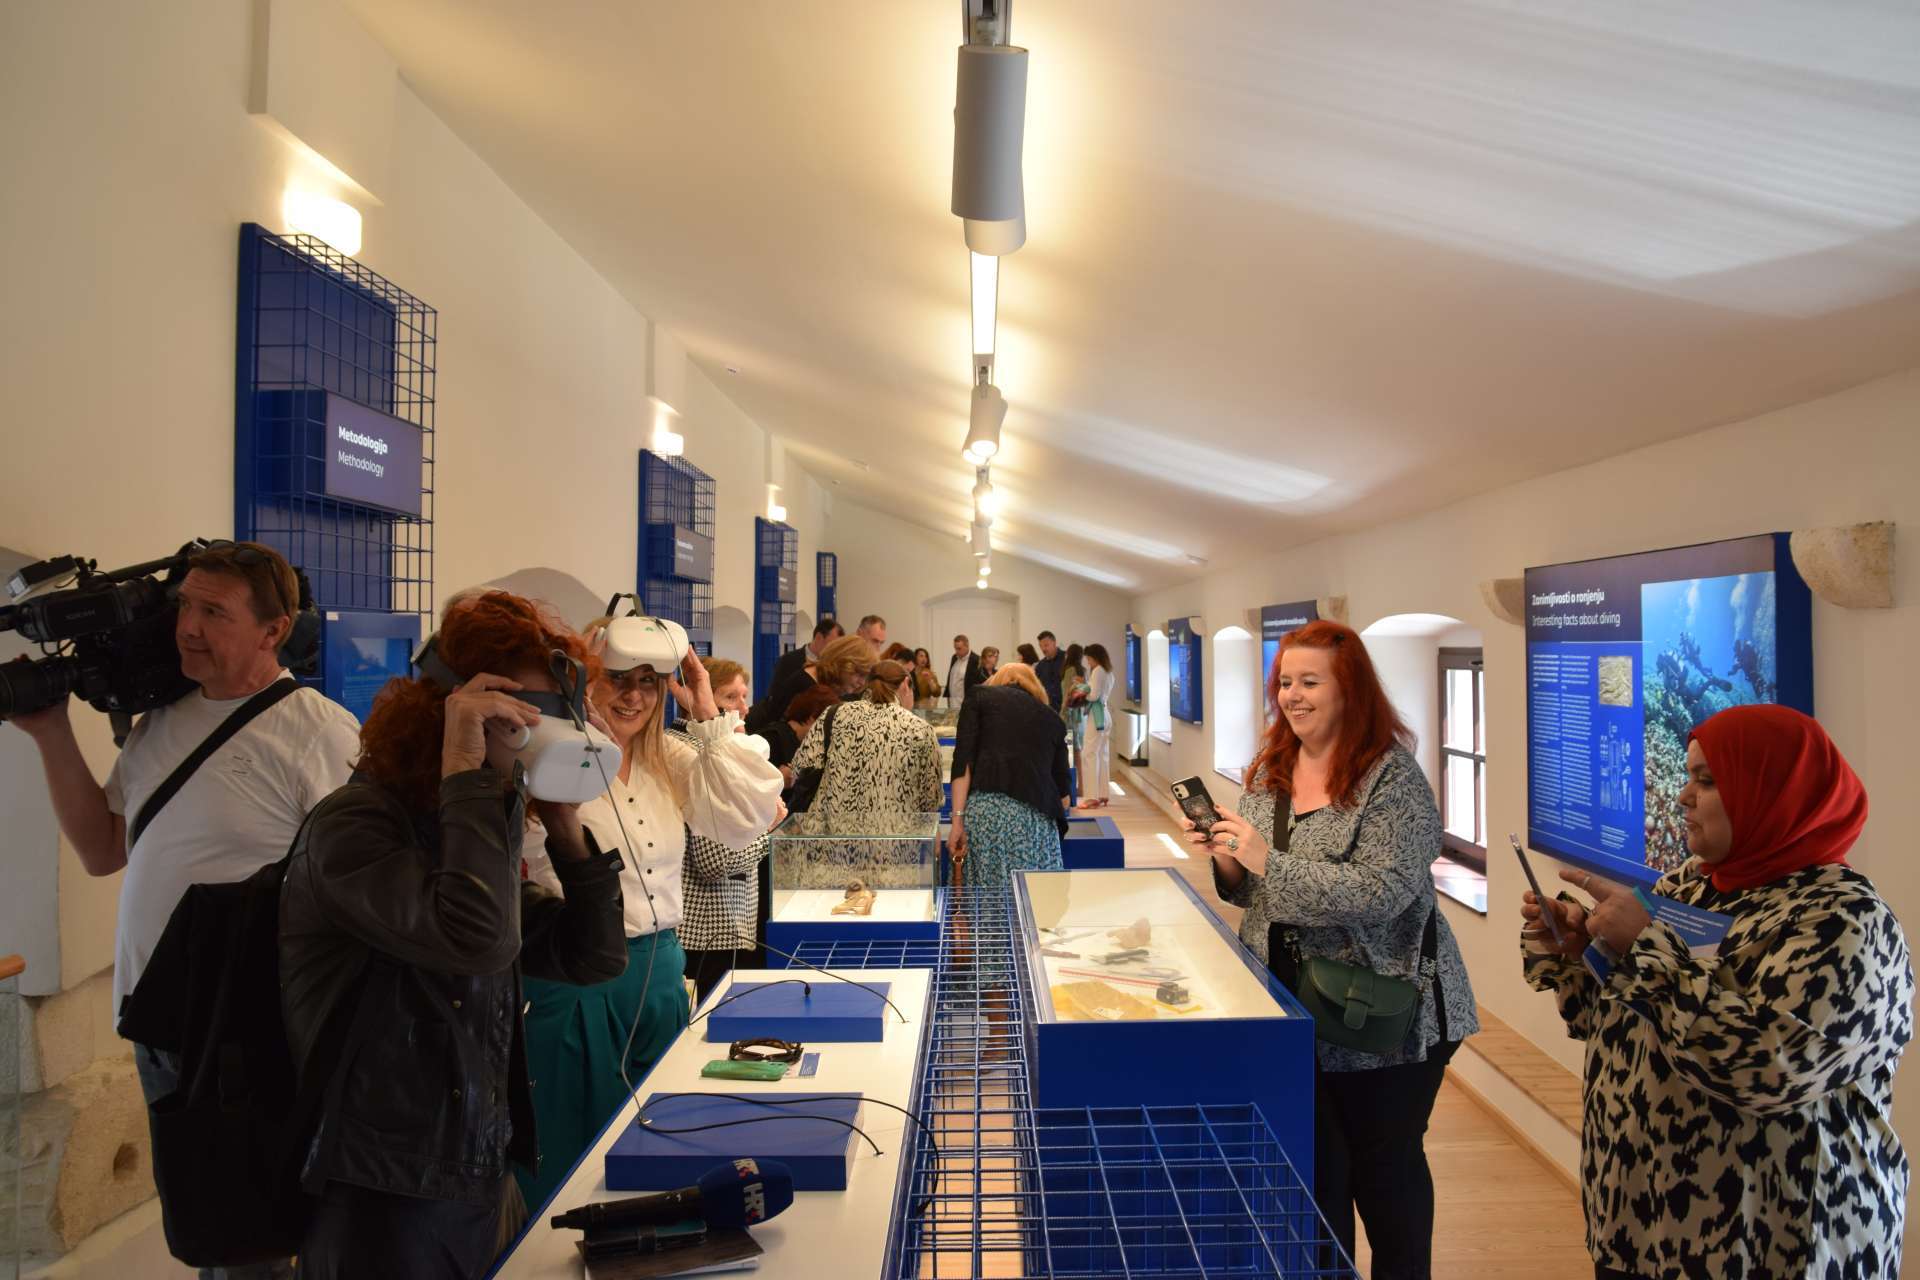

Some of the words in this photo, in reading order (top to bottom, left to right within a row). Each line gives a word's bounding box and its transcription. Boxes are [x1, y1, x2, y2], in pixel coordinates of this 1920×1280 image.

[338, 425, 388, 455] Metodologija
[338, 450, 384, 477] Methodology
[1532, 591, 1570, 607] Zanimljivosti
[1571, 594, 1576, 604] o
[1576, 588, 1604, 605] ronjenju
[1532, 614, 1562, 629] Interesting
[1563, 613, 1578, 627] facts
[1579, 612, 1598, 626] about
[1600, 611, 1621, 628] diving
